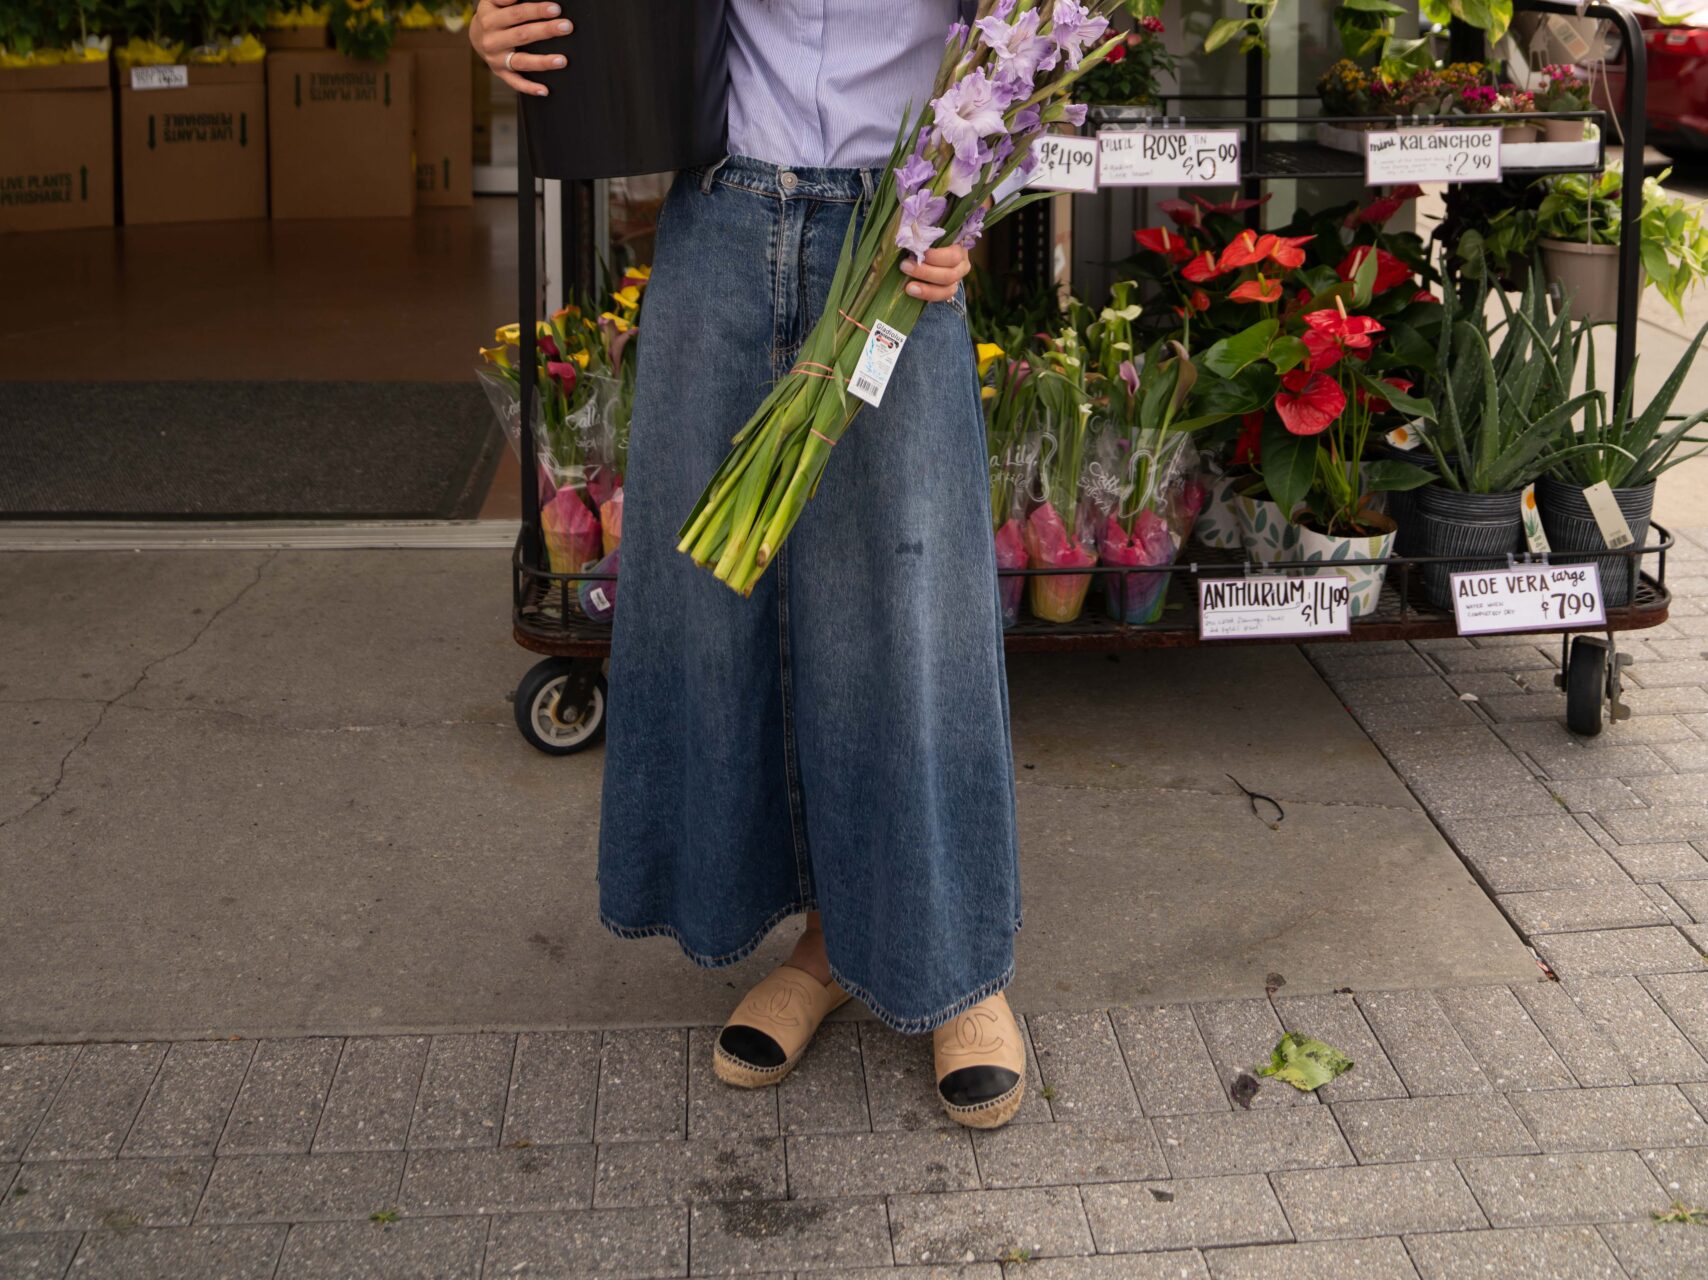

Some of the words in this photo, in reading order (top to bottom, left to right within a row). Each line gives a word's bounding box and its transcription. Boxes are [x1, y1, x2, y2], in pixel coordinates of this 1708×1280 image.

[1100, 135, 1134, 153] mini
[1370, 137, 1395, 152] mini
[28, 172, 72, 188] PLANTS
[876, 322, 904, 343] Gladiolus
[1459, 577, 1499, 598] ALOE
[1506, 574, 1550, 594] VERA
[1552, 569, 1586, 587] large
